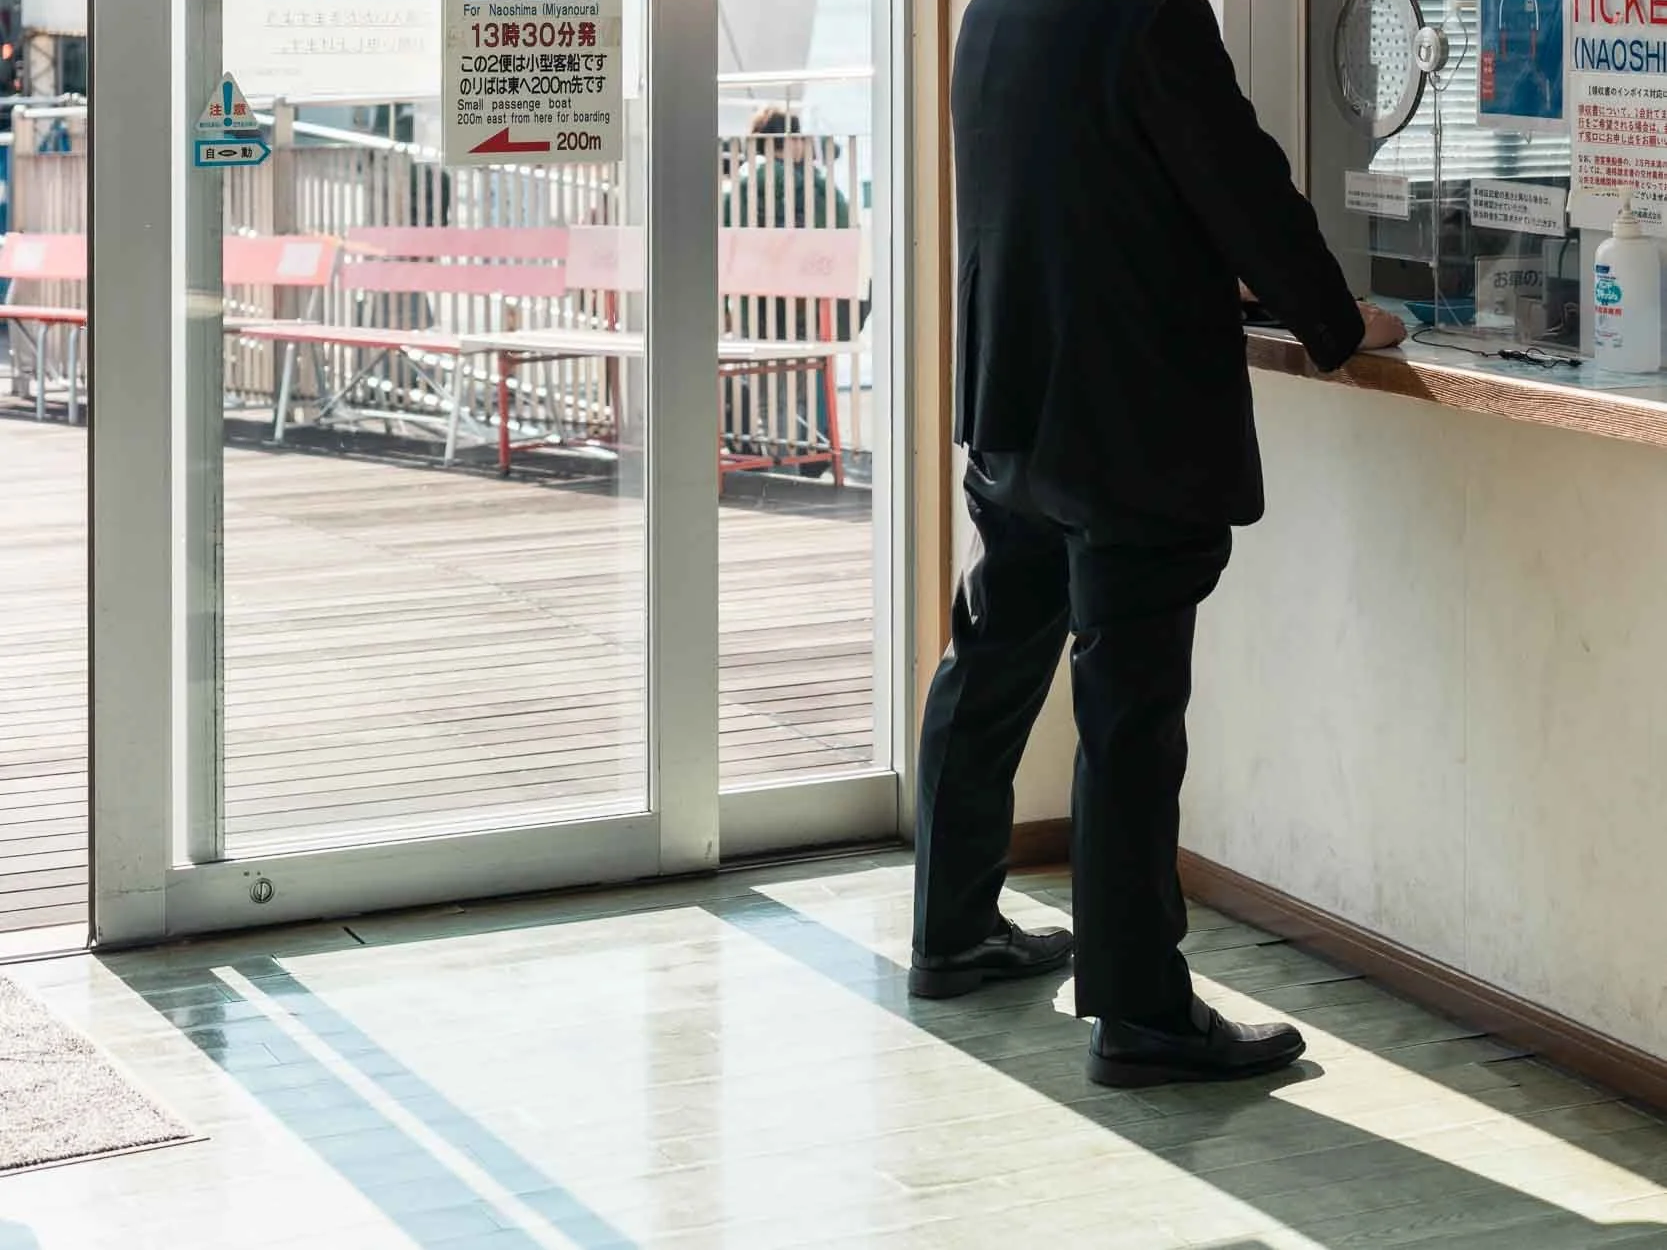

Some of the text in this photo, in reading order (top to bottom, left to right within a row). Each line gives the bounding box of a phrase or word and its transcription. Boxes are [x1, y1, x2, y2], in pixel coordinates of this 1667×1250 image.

[464, 3, 599, 17] For Naoshima (Miyanoura)
[472, 22, 596, 48] 13時30分発
[461, 54, 607, 72] この2便は小型客船です
[460, 76, 606, 95] のりばは東へ200m先です
[458, 98, 571, 112] Small passenge boat
[458, 111, 610, 124] 200m east from here for boarding
[557, 132, 601, 150] 200m
